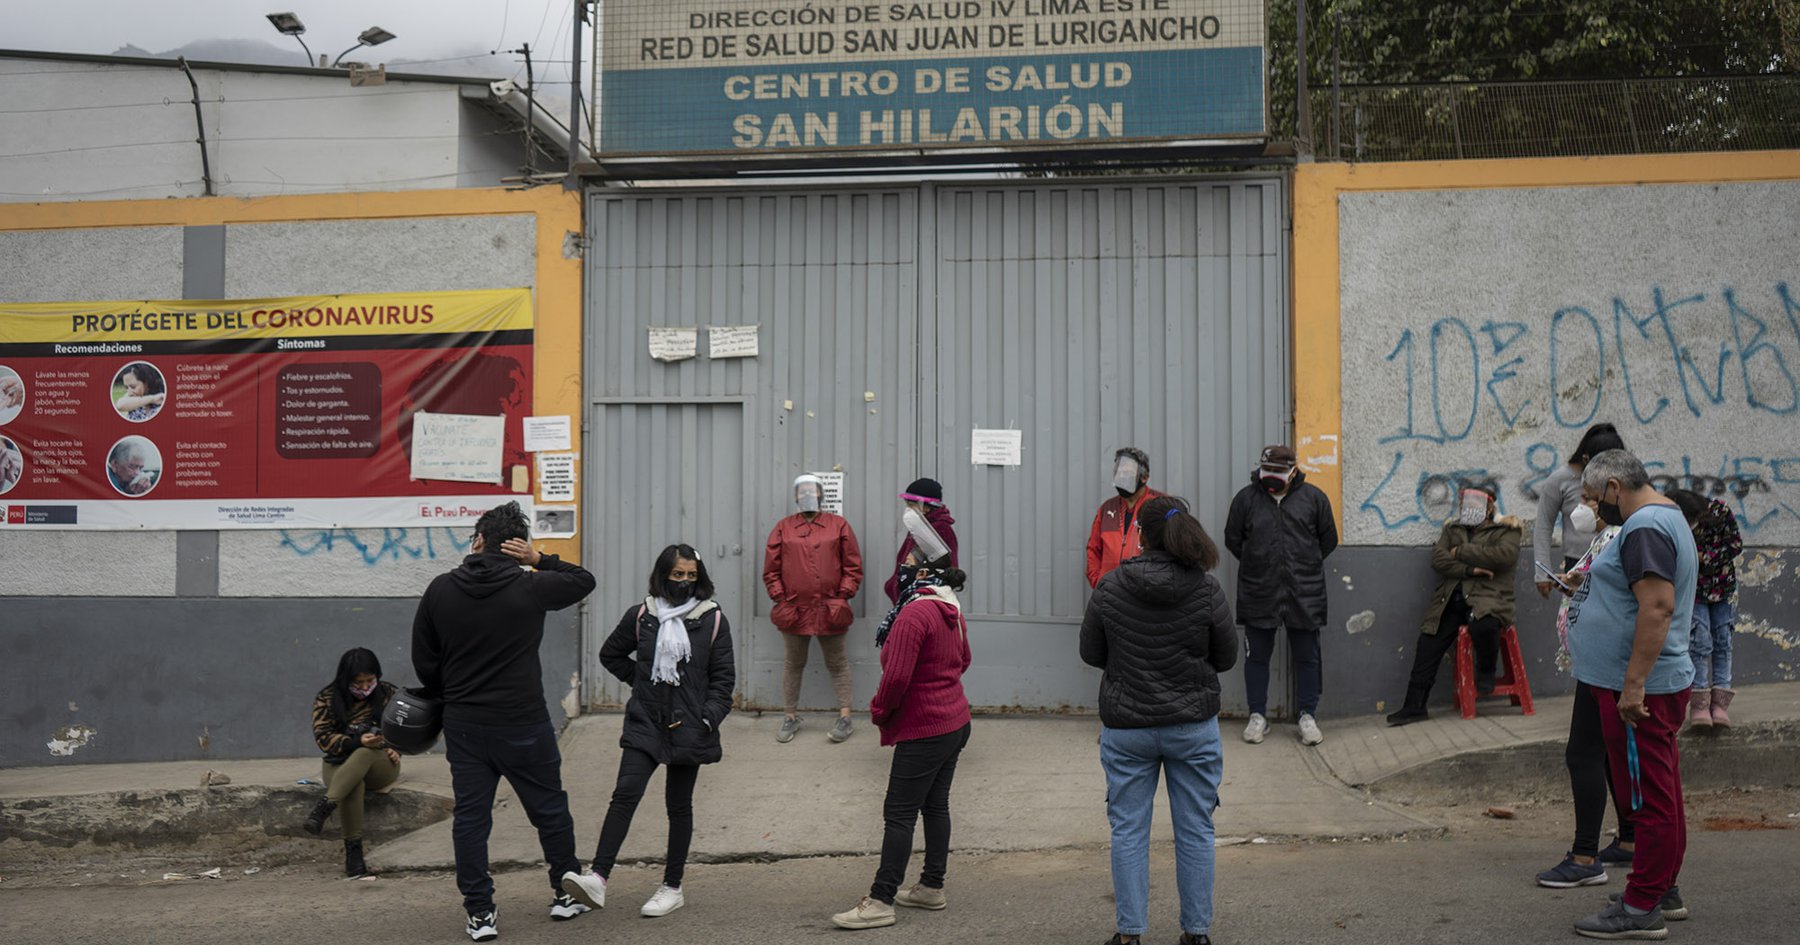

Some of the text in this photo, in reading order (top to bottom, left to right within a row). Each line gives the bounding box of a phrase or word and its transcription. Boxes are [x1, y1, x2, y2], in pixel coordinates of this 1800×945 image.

[690, 0, 1169, 29] DIRECCIÓN DE SALUD IV LIMA ESTE
[641, 15, 1221, 61] RED DE SALUD SAN JUAN DE LURIGANCHO
[723, 61, 1132, 100] CENTRO DE SALUD
[732, 95, 1123, 148] SAN HILARIÓN
[72, 304, 434, 332] PROTÉGETE DEL CORONAVIRUS
[55, 342, 143, 354] Recomendaciones
[277, 338, 326, 349] Síntomas
[213, 372, 220, 380] el
[286, 373, 308, 381] Fiebre
[286, 400, 306, 408] Dolor
[306, 400, 316, 408] de
[286, 414, 315, 422] Malestar
[316, 414, 342, 423] general
[321, 441, 331, 449] de
[348, 440, 357, 448] de
[176, 469, 212, 478] problemas
